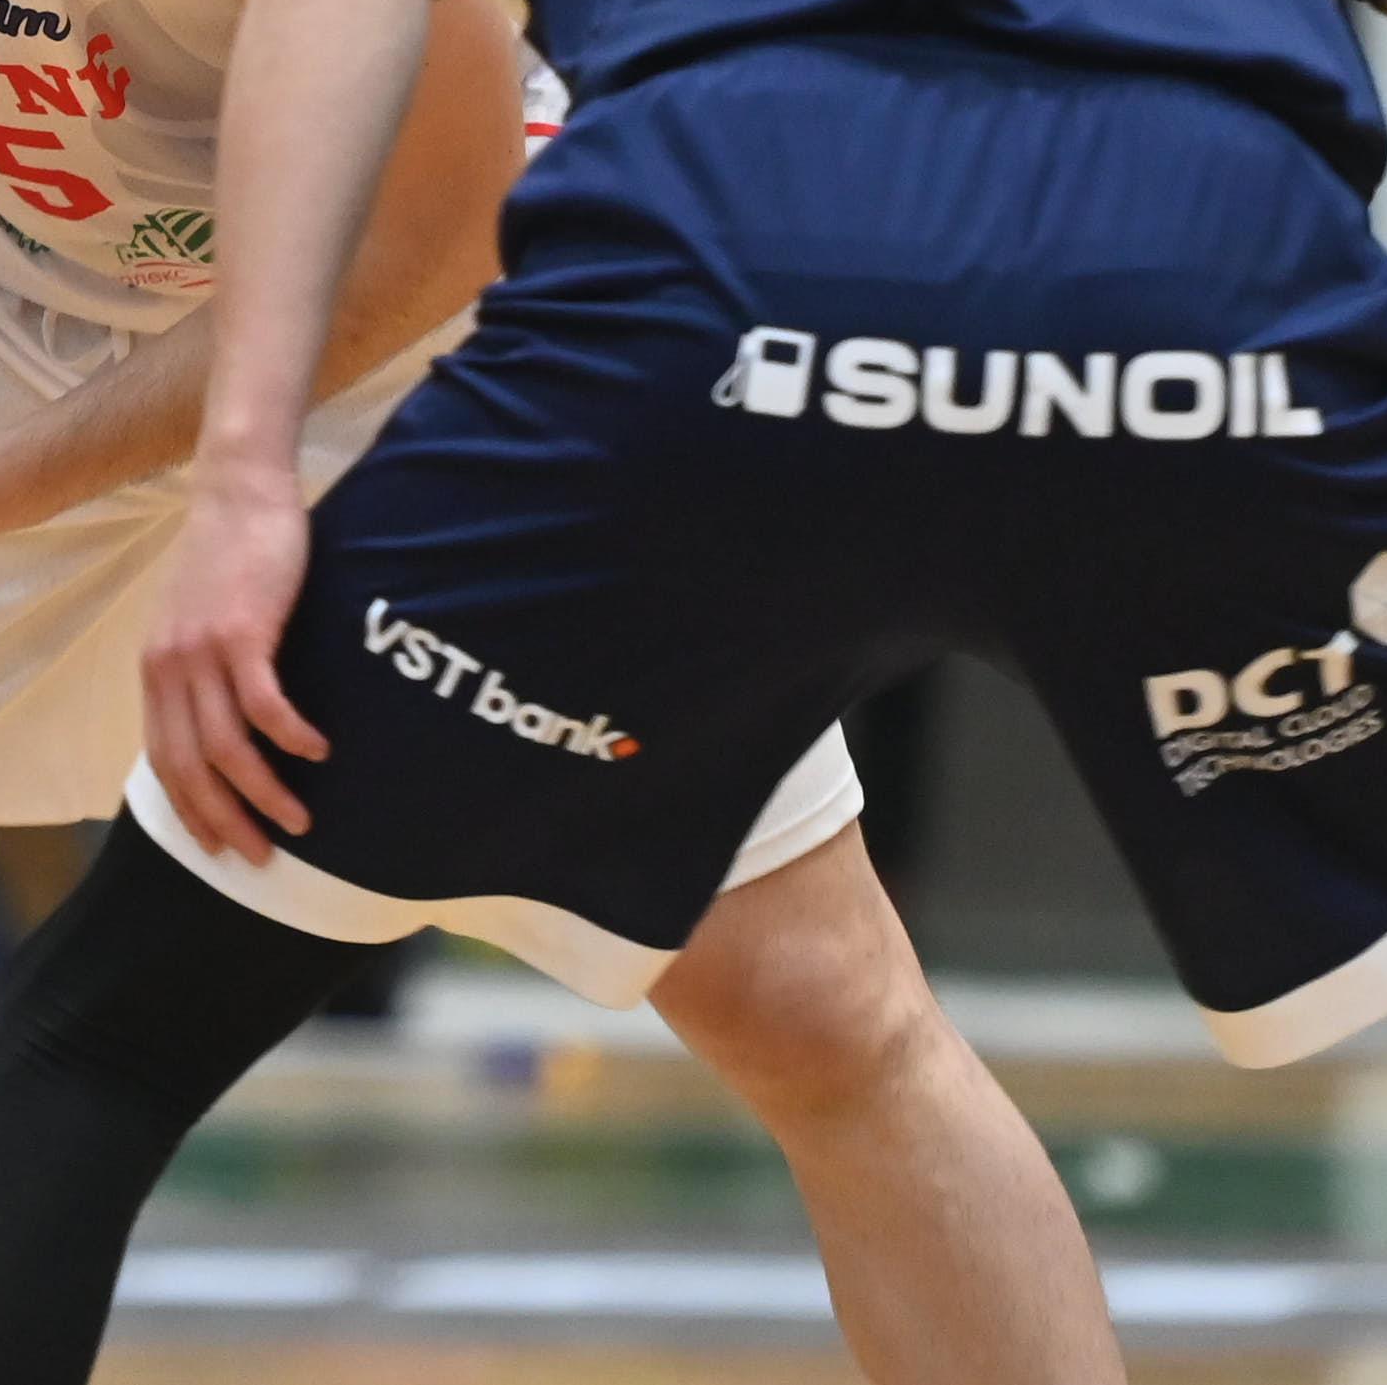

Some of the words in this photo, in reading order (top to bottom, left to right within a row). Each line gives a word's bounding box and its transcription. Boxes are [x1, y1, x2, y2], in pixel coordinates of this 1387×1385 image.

[821, 336, 1325, 441] SUNOIL
[364, 597, 484, 698] VST
[470, 670, 627, 762] bank
[1142, 630, 1359, 740] DCT
